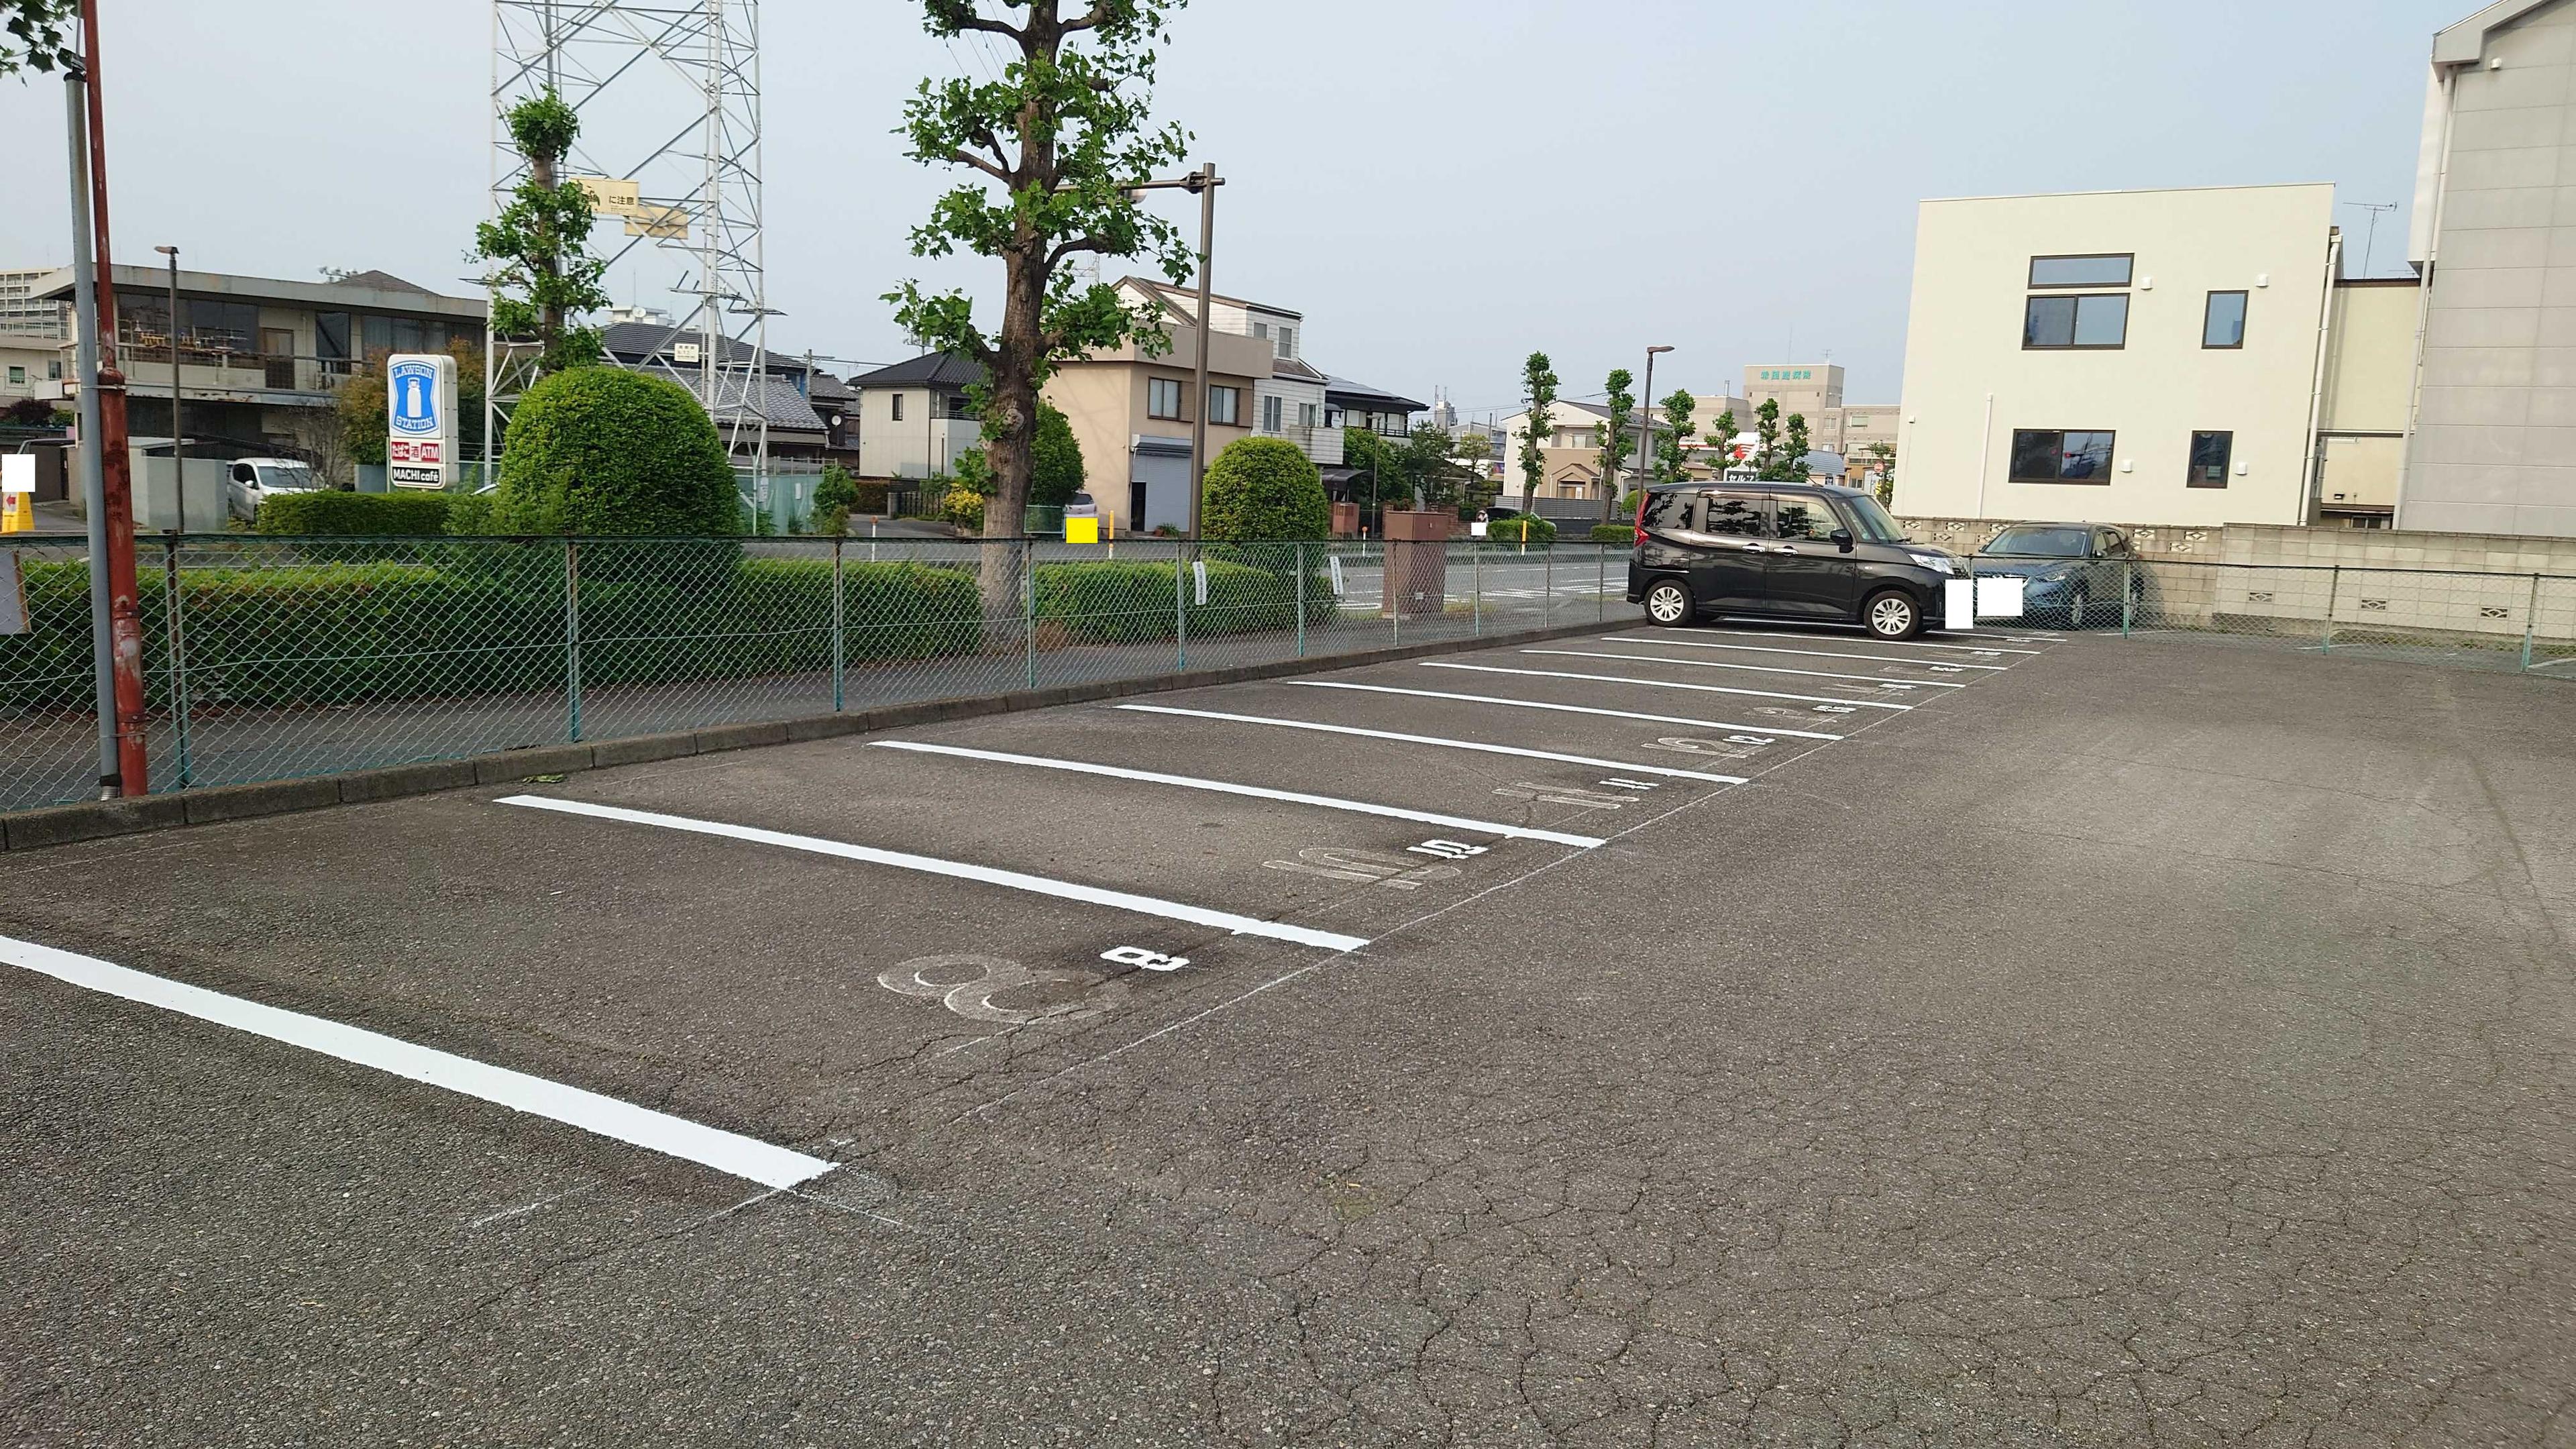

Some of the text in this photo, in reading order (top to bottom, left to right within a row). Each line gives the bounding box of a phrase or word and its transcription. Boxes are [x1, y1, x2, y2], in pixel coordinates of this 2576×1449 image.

[394, 364, 433, 379] LAWSON
[395, 415, 434, 429] STATION
[392, 443, 409, 458] たばこ
[421, 445, 439, 460] ATM
[393, 468, 420, 481] MACHI
[1722, 735, 1776, 746] 12
[1599, 777, 1660, 790] 11
[1406, 839, 1489, 860] 10
[1100, 946, 1190, 971] 8
